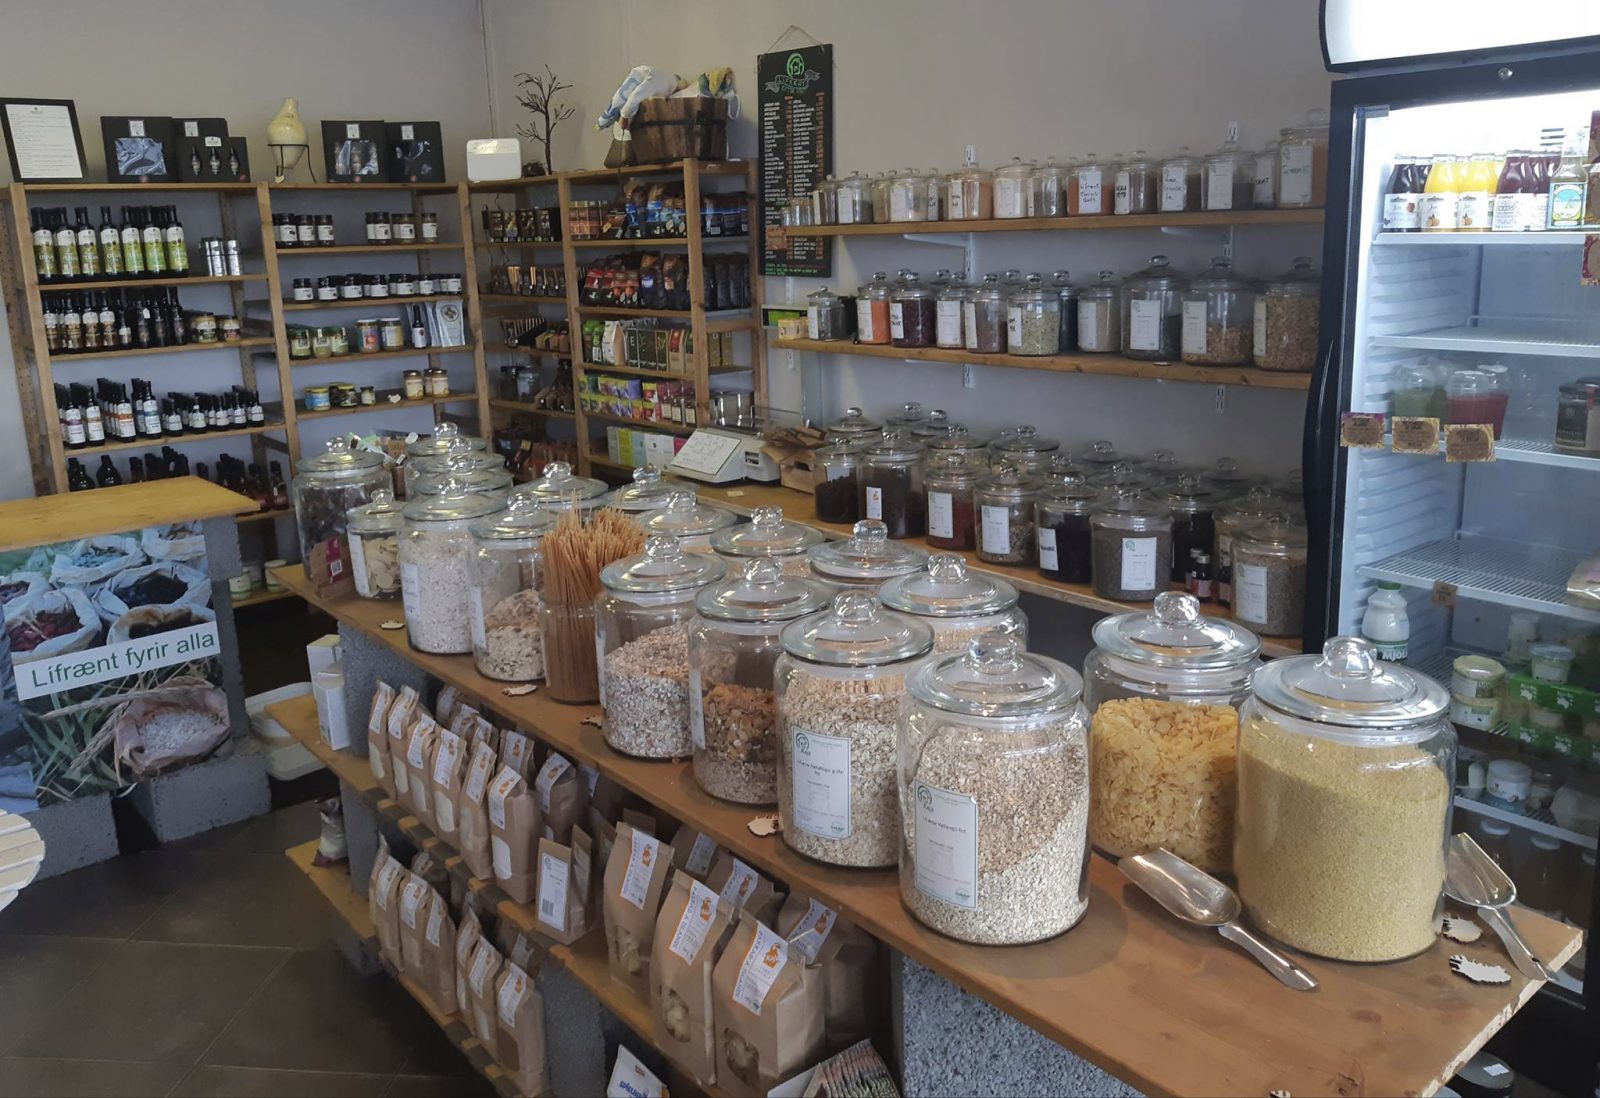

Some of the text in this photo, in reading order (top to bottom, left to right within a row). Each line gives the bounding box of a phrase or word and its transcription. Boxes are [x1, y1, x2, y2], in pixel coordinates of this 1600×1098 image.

[32, 632, 215, 688] Lífrænt fyrir alla
